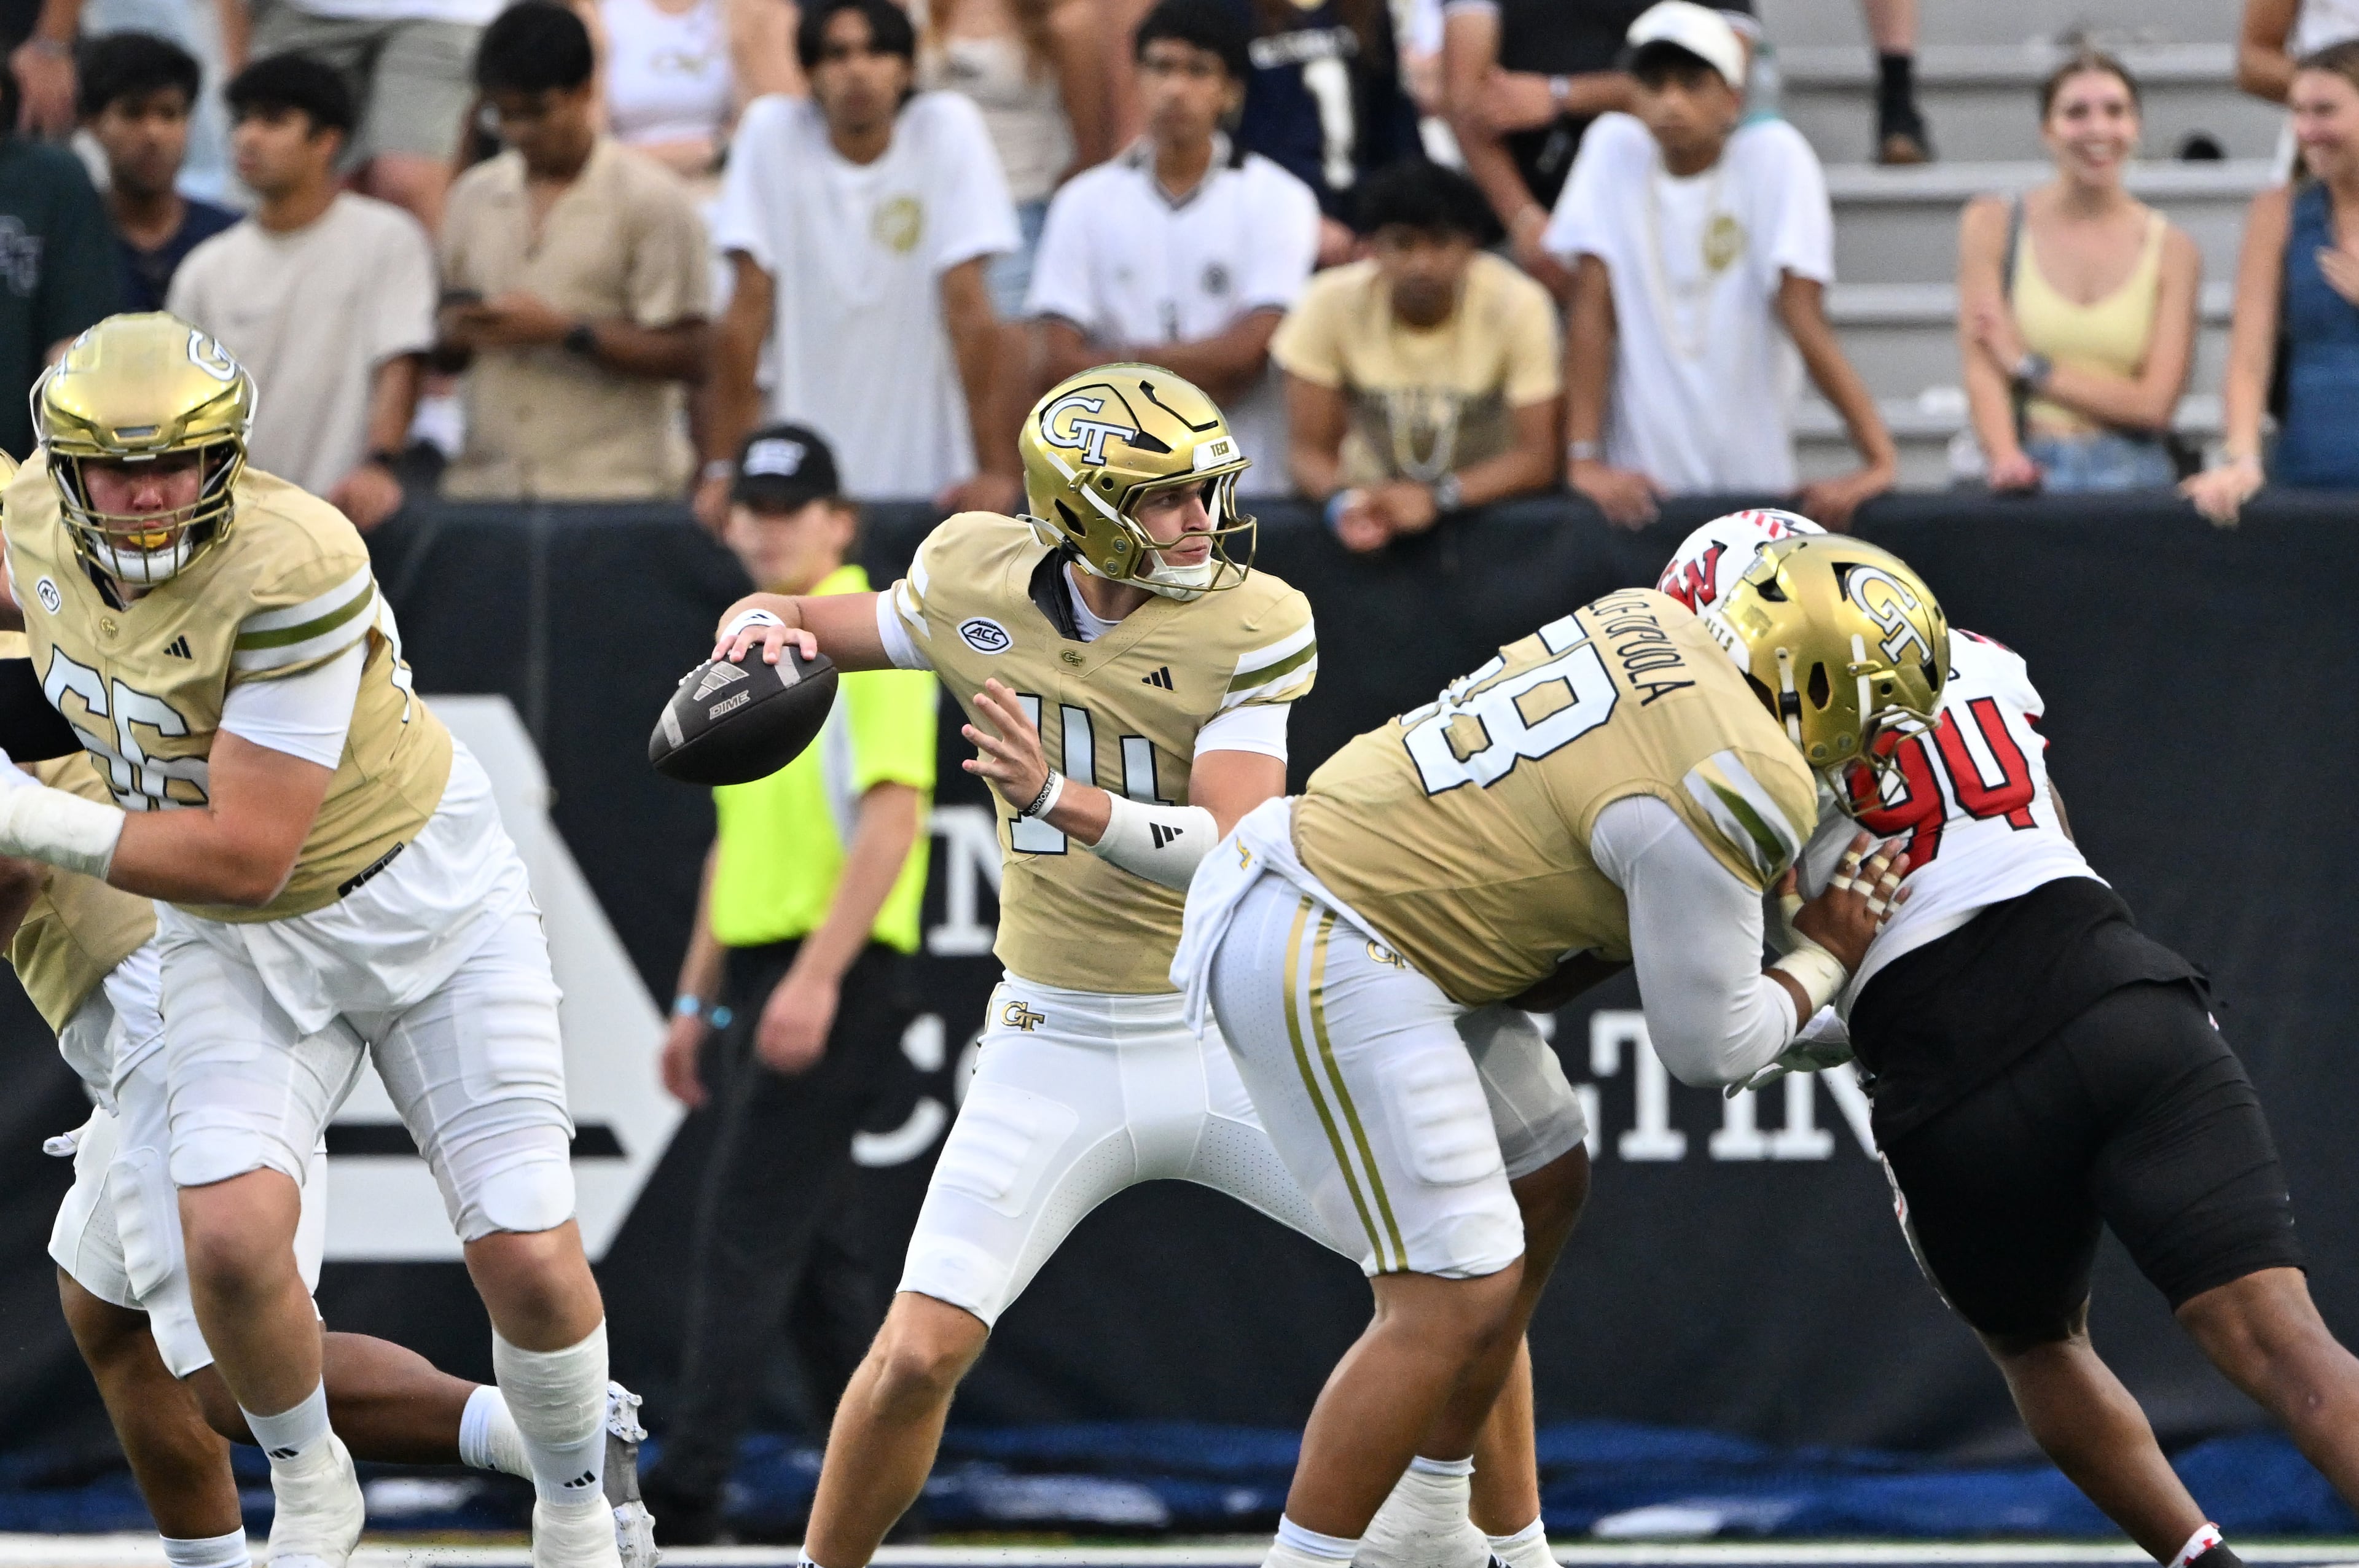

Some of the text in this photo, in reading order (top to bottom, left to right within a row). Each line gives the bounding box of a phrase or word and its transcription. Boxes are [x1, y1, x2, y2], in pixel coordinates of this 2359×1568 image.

[1041, 396, 1141, 466] GT
[968, 627, 1003, 642] ACC
[1845, 564, 1935, 665] GT
[43, 643, 211, 811] 66
[709, 690, 751, 720] DIME
[1028, 783, 1052, 814] ENOUGH
[1844, 695, 2039, 882] 94
[1000, 1001, 1044, 1032] GT
